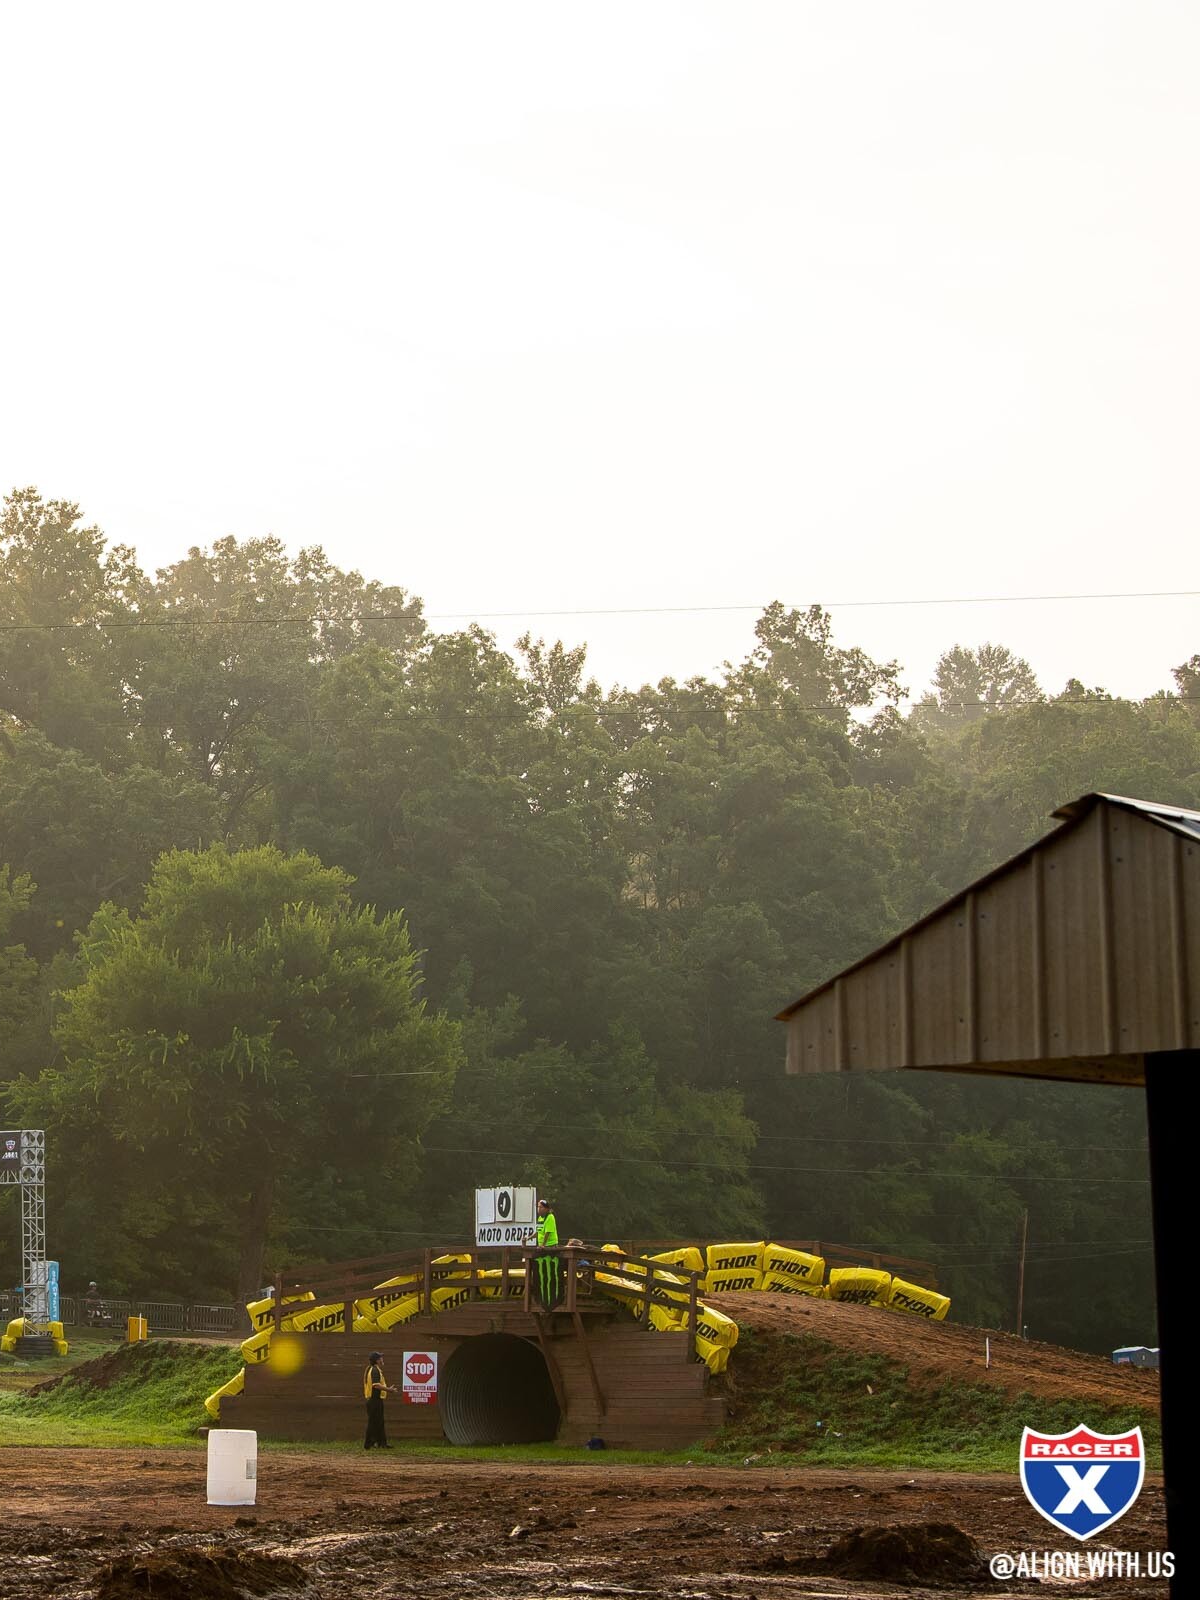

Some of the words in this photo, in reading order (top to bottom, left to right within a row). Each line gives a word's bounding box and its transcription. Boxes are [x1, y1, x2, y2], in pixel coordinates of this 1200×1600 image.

[498, 1190, 511, 1218] 0
[479, 1227, 502, 1242] MOTO
[505, 1226, 534, 1242] ORDER
[716, 1254, 757, 1270] THOR
[770, 1259, 810, 1277] THOR
[713, 1278, 755, 1292] THOR
[893, 1291, 937, 1318] THOR
[696, 1320, 719, 1342] HOR
[406, 1362, 434, 1375] STOP
